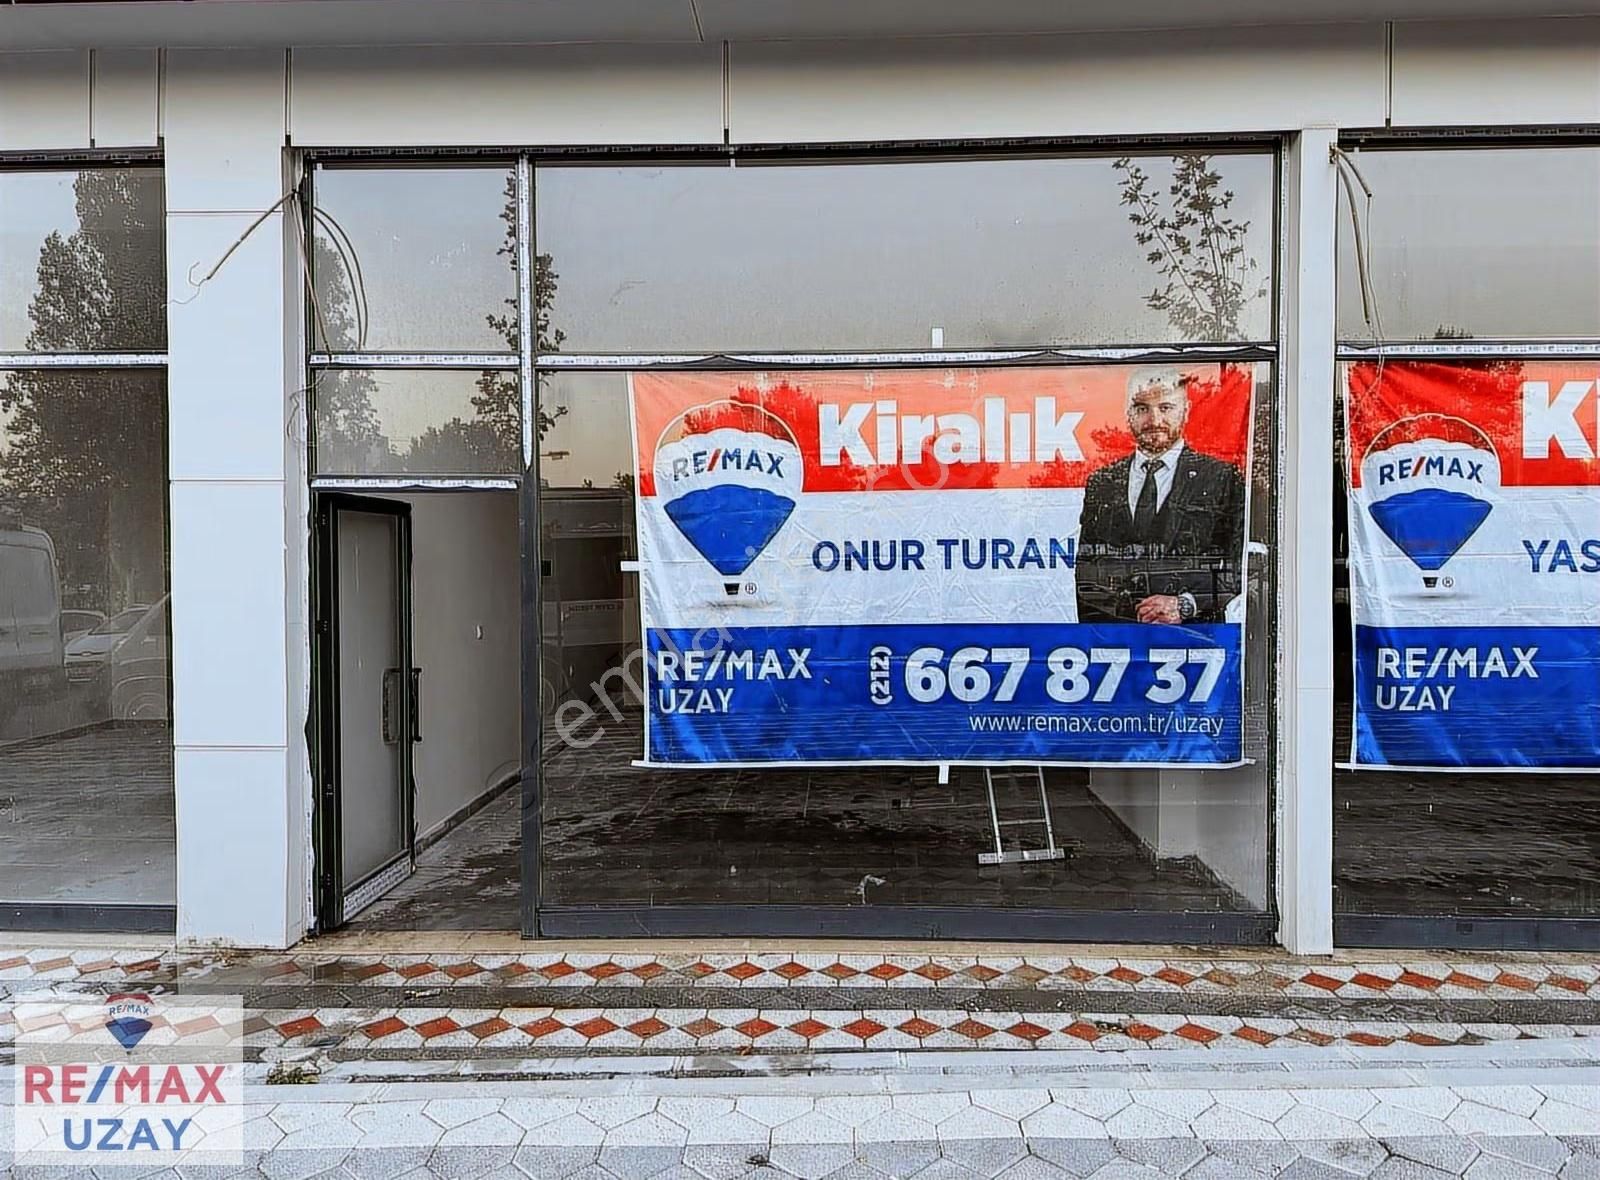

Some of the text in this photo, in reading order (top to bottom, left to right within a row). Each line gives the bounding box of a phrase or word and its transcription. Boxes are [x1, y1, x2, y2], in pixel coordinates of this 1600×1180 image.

[818, 396, 1085, 468] Kiralık
[1522, 379, 1600, 459] K
[672, 447, 785, 482] RE/MAX
[1379, 457, 1483, 485] RE/MAX
[812, 537, 1077, 572] ONUR TURAN
[1522, 539, 1600, 573] YAS
[656, 648, 812, 682] RE/MAX
[870, 646, 1226, 705] (212) 667 87 37
[1377, 647, 1539, 679] RE/MAX
[659, 688, 734, 715] UZAY
[1375, 686, 1455, 711] UZAY
[969, 713, 1224, 736] www.remax.com.tr/uzay
